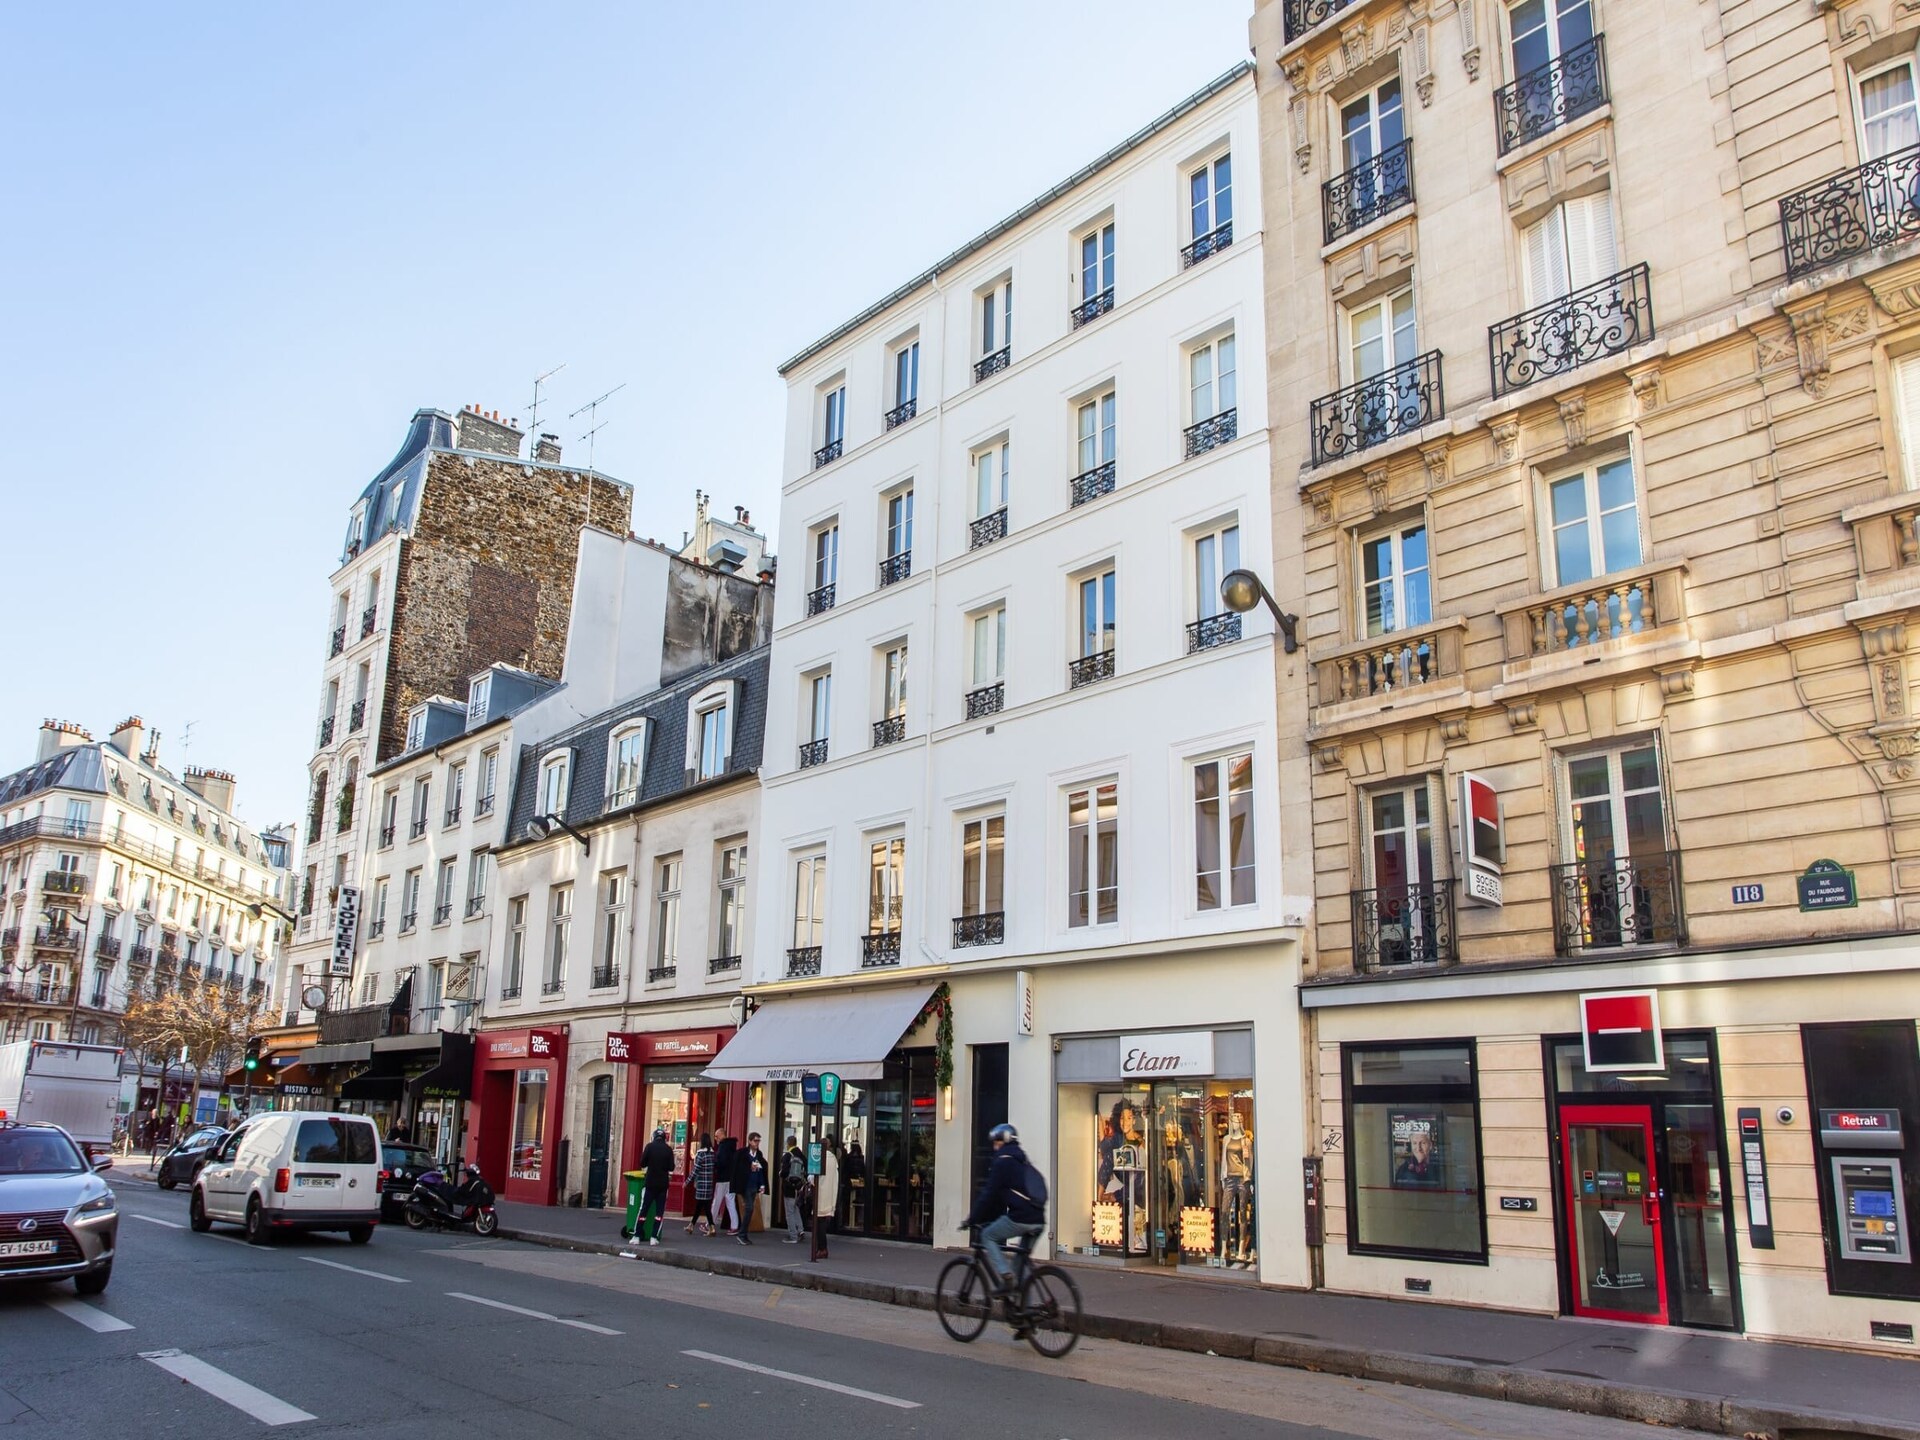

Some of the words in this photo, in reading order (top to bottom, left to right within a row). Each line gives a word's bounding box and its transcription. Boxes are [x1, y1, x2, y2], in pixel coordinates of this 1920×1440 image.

[1735, 885, 1760, 902] 118
[1816, 887, 1844, 895] FAUBOURG
[334, 888, 357, 965] BIJOUTERIE
[1022, 987, 1032, 1032] Etam
[1122, 1048, 1181, 1073] Etam
[765, 1069, 782, 1080] PARIS
[782, 1069, 795, 1079] NEW
[284, 1084, 308, 1094] BISTRO
[1394, 1121, 1411, 1131] 598
[1412, 1121, 1431, 1131] 539
[1841, 1116, 1879, 1126] Retrait
[0, 1241, 50, 1255] EV-149-KA
